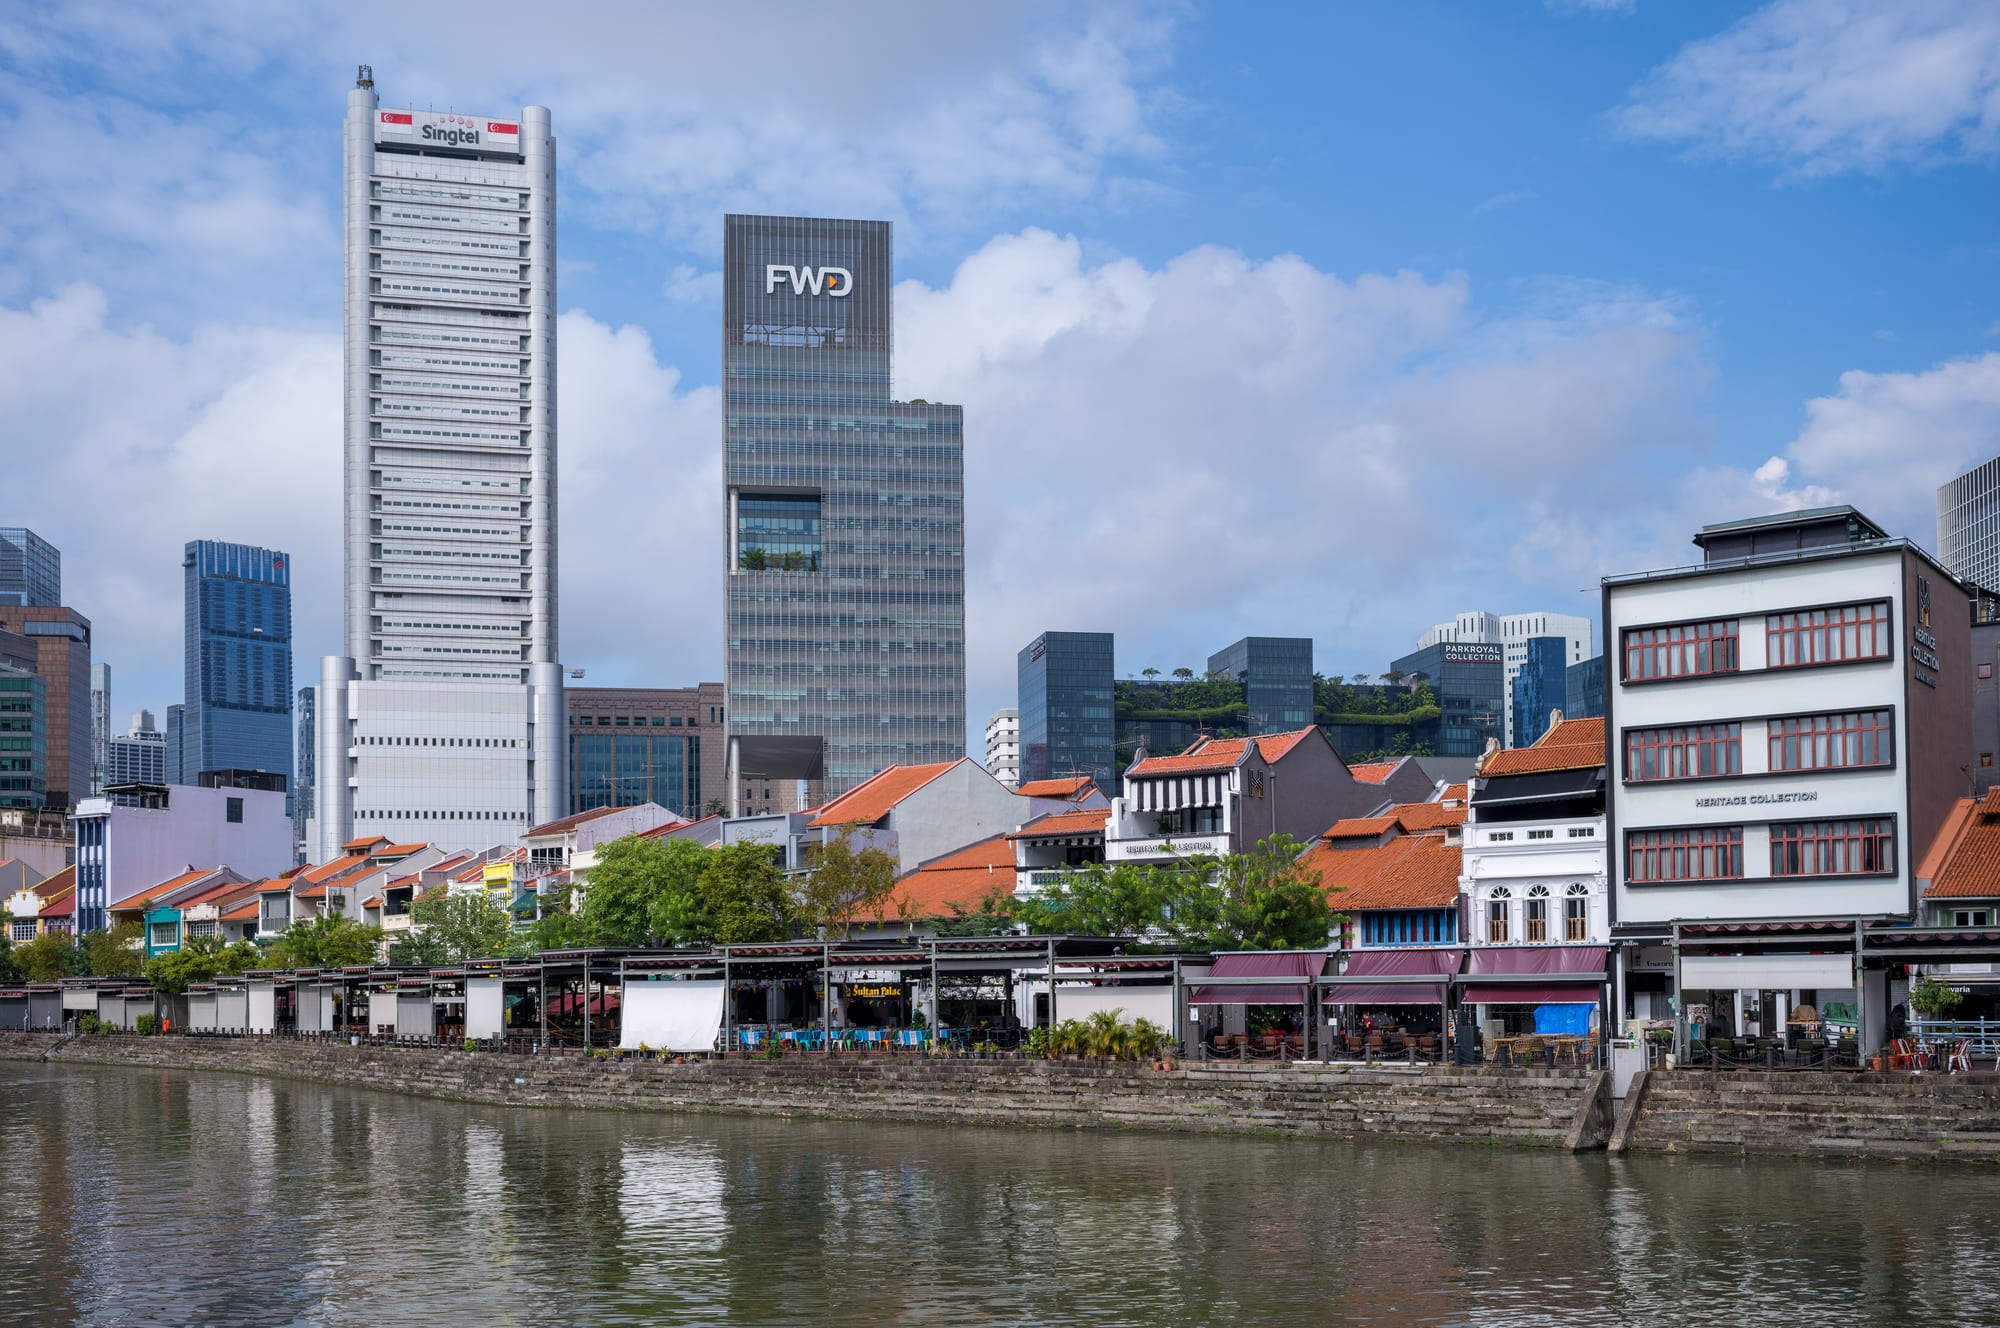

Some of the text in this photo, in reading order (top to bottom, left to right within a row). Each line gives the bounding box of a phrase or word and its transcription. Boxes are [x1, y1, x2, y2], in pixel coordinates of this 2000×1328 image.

[422, 124, 479, 146] Singtel
[766, 264, 853, 297] FWD
[1914, 628, 1936, 650] HERITAGE
[1445, 645, 1500, 654] PARKROYAL
[1445, 653, 1500, 661] COLLECTION
[1912, 646, 1939, 671] COLLECTION
[1695, 791, 1817, 808] HERITAGE COLLECTION
[853, 983, 901, 996] Sultan Palac
